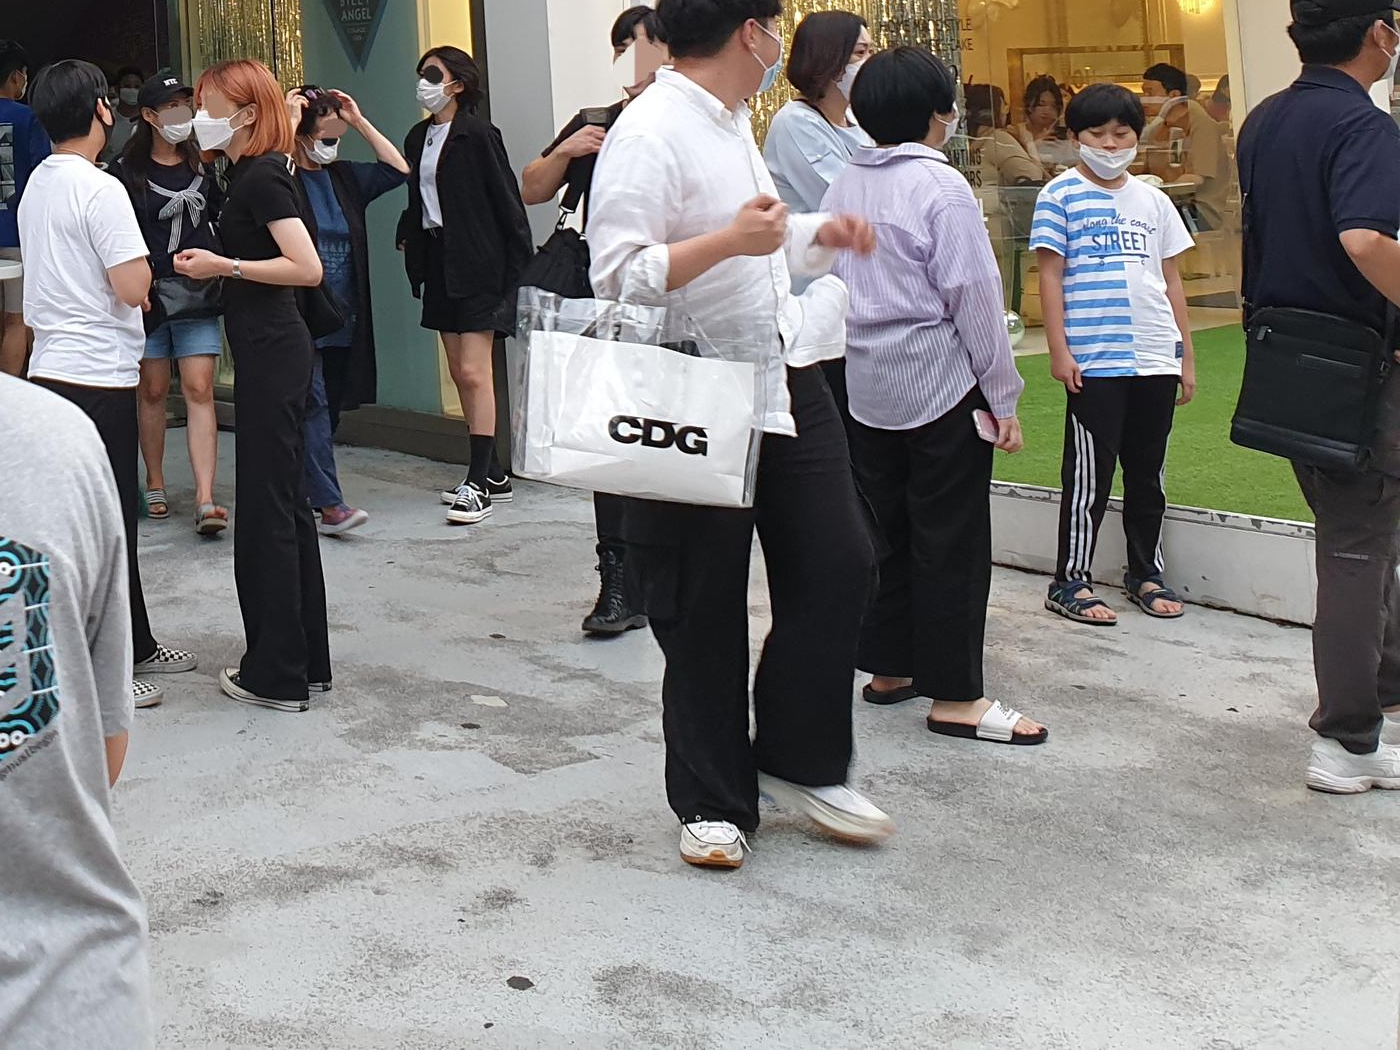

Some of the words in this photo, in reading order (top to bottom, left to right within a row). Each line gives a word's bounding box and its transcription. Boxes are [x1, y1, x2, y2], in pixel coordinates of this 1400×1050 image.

[341, 8, 372, 22] ANGEL
[1092, 231, 1146, 251] STREET
[608, 415, 709, 457] CDG
